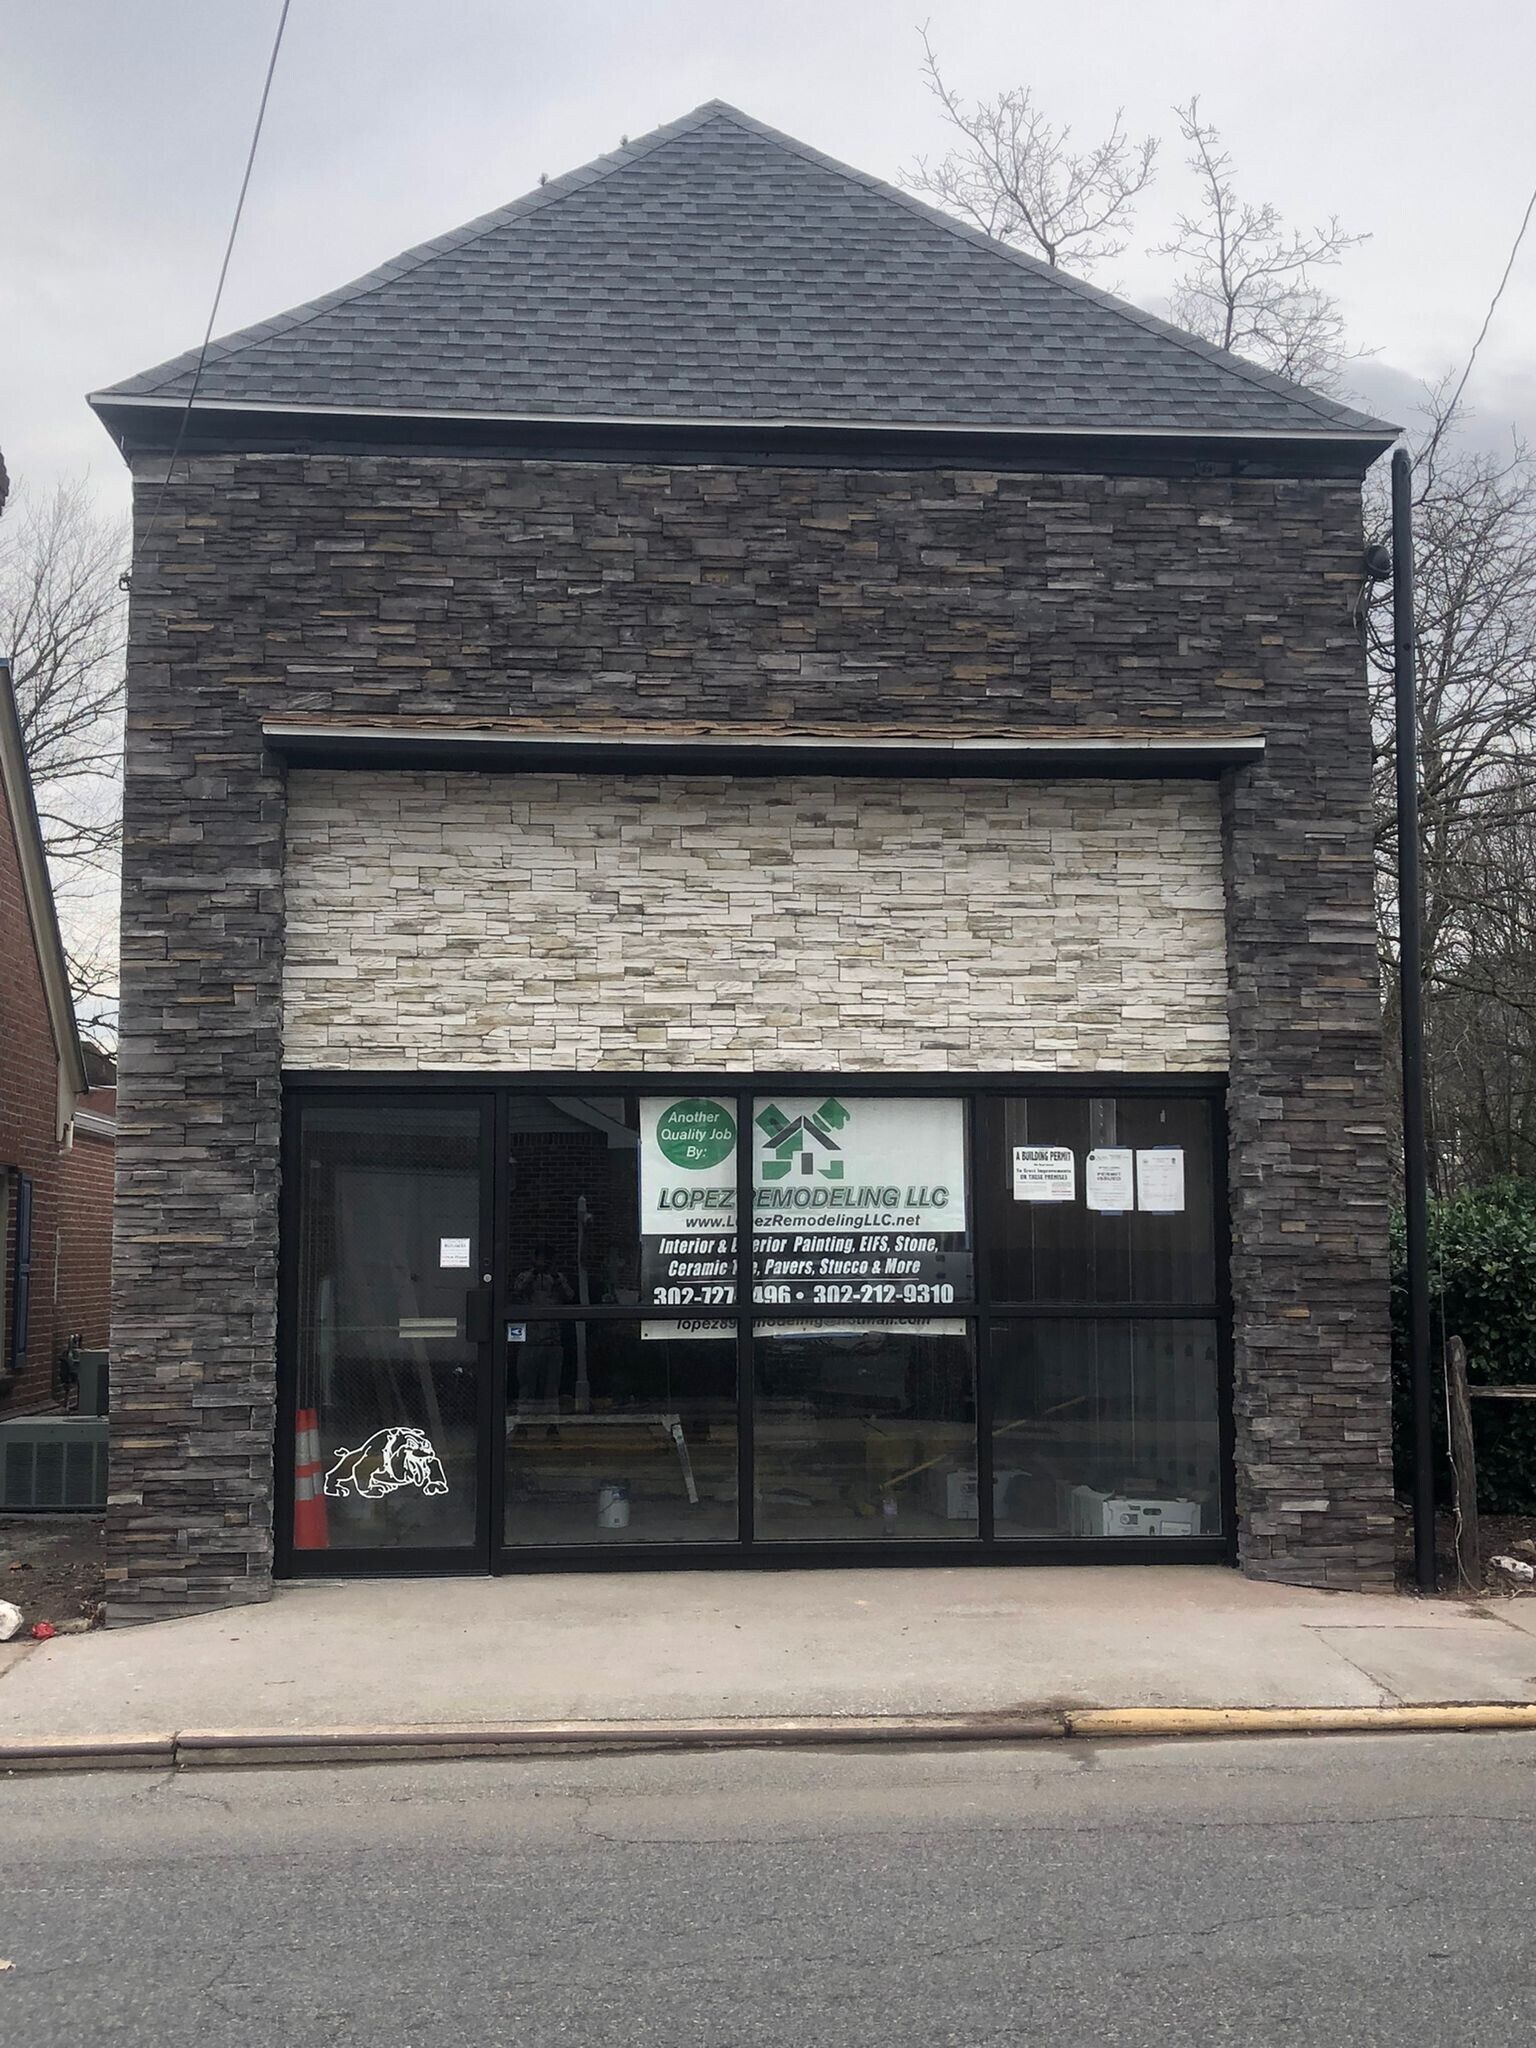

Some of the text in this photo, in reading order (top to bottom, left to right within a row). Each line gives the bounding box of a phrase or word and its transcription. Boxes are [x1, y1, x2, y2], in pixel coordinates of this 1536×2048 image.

[668, 1111, 720, 1123] Another
[661, 1128, 732, 1142] Quality Job
[686, 1145, 707, 1160] By:
[1016, 1151, 1071, 1161] A BUILDING PERMIT
[657, 1186, 949, 1210] LOPEZ EMODELING LLC
[685, 1213, 920, 1229] www.LezRemodelingLLC.net
[659, 1235, 938, 1254] Interior & Eerior Painting, EIFS, Stone,
[668, 1260, 728, 1277] Ceramic
[764, 1259, 815, 1275] Pavers,
[820, 1258, 868, 1274] Stucco
[871, 1260, 881, 1274] &
[885, 1258, 920, 1274] More
[813, 1284, 954, 1303] 302-212-9310
